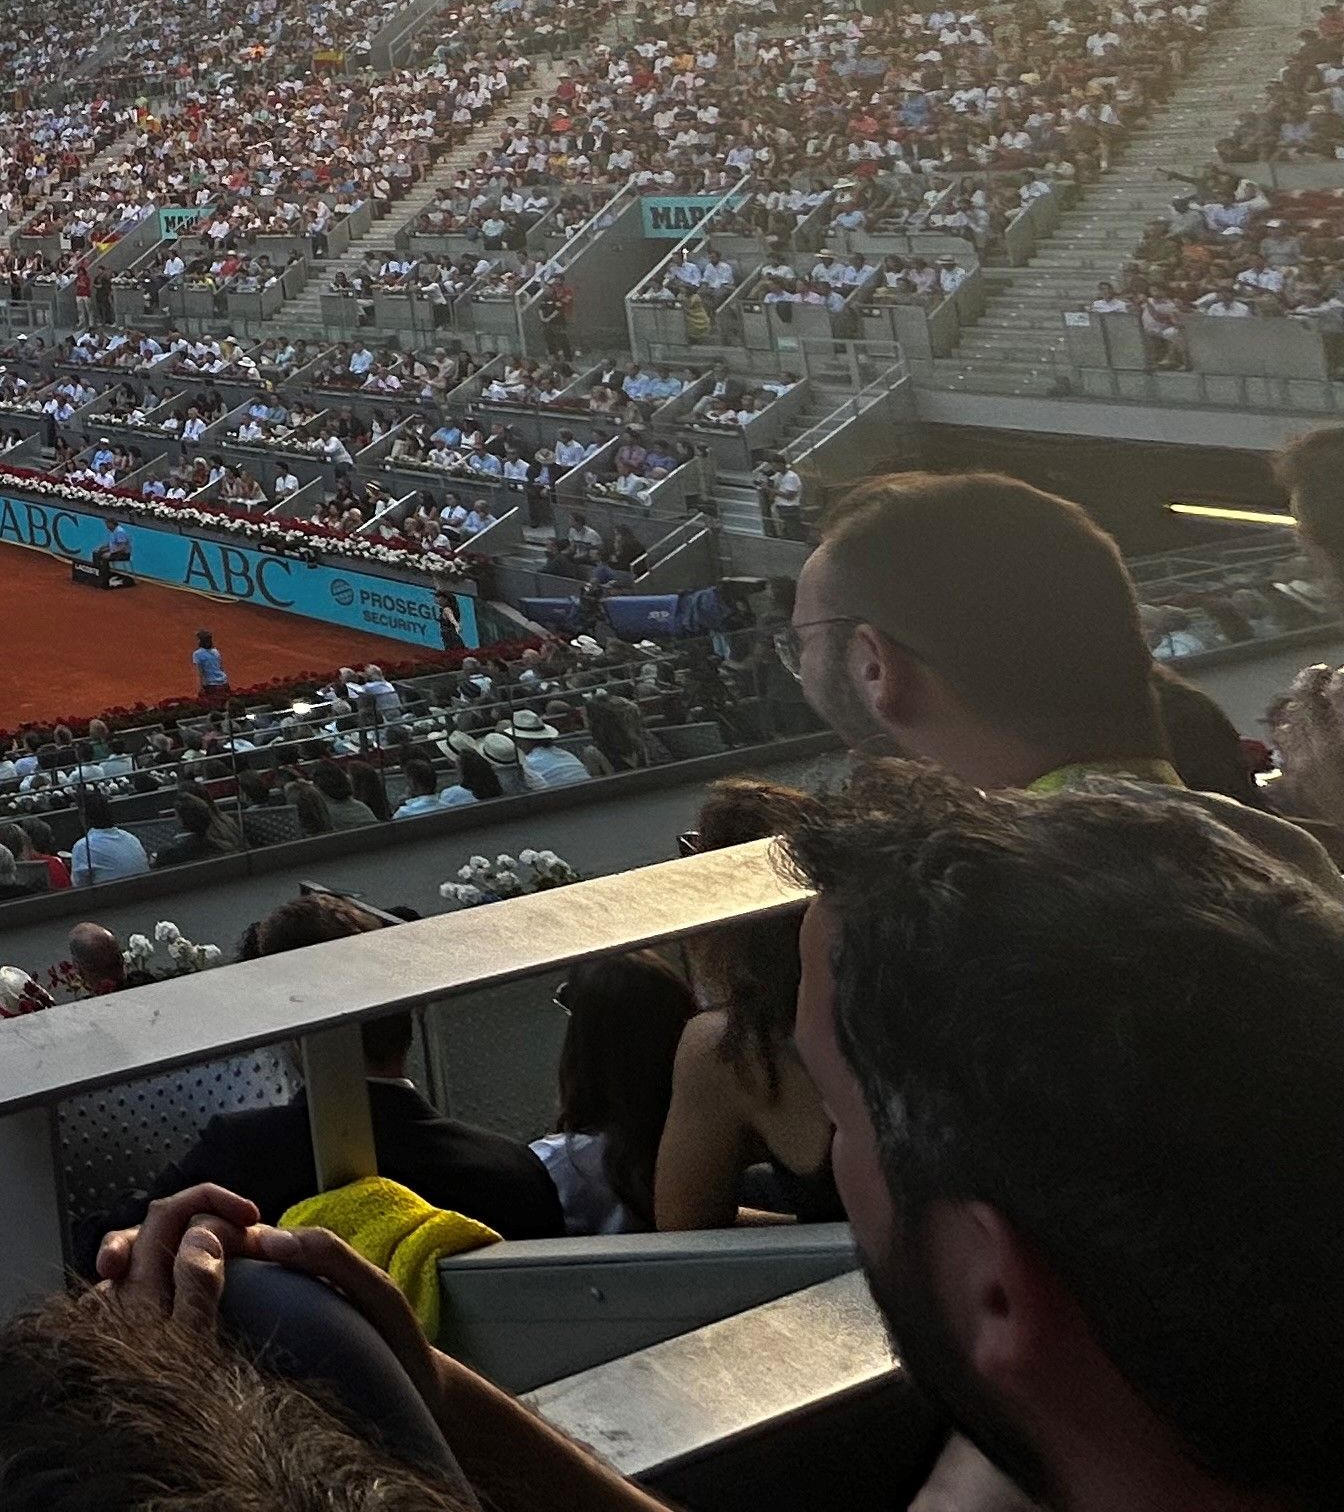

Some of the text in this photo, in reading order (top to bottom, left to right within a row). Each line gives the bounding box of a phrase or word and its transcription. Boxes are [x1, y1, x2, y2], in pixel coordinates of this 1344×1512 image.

[0, 500, 81, 554] ABC
[183, 539, 295, 608] ABC
[363, 610, 428, 636] SECURITY
